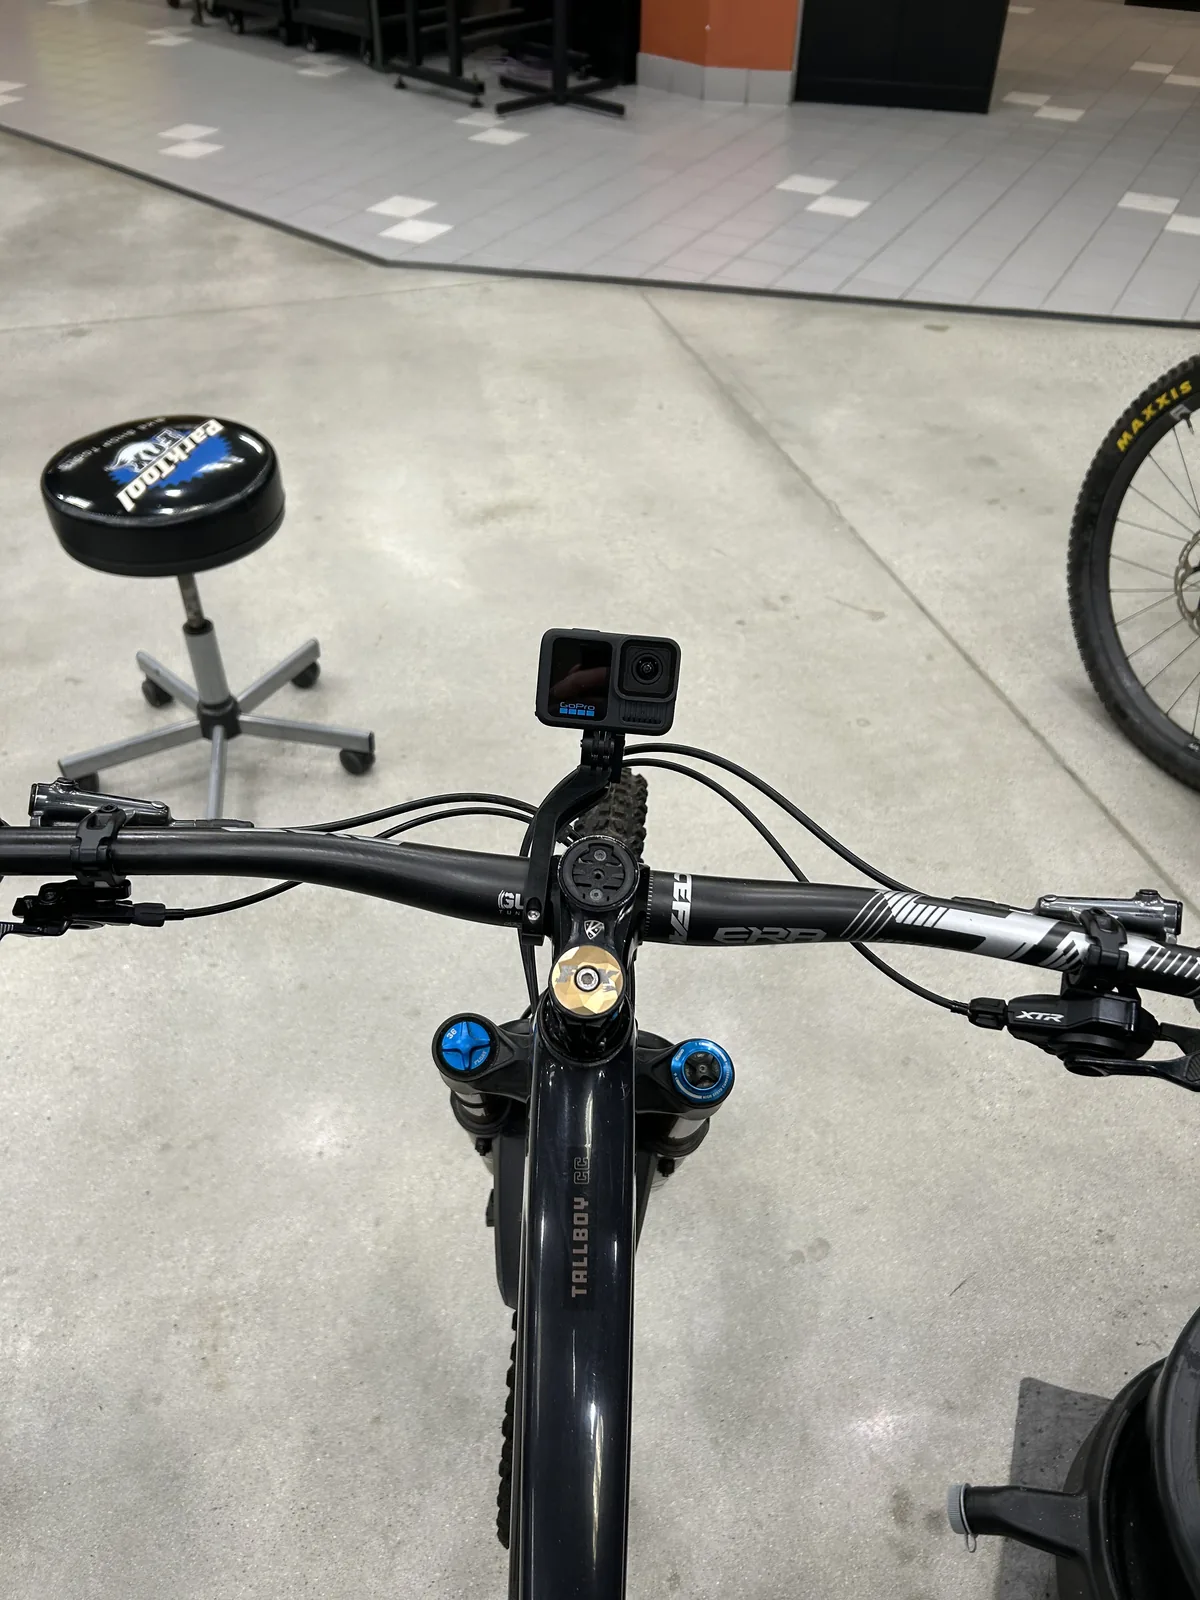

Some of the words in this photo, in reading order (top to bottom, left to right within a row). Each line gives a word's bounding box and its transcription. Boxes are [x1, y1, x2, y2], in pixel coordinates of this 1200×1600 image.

[1116, 380, 1192, 452] MAXXIS
[559, 701, 596, 711] GoPro
[713, 926, 827, 944] ERA
[1015, 1010, 1065, 1023] XTR
[446, 1028, 458, 1040] 36
[573, 1156, 590, 1185] CC
[571, 1196, 589, 1298] TALLBOY
